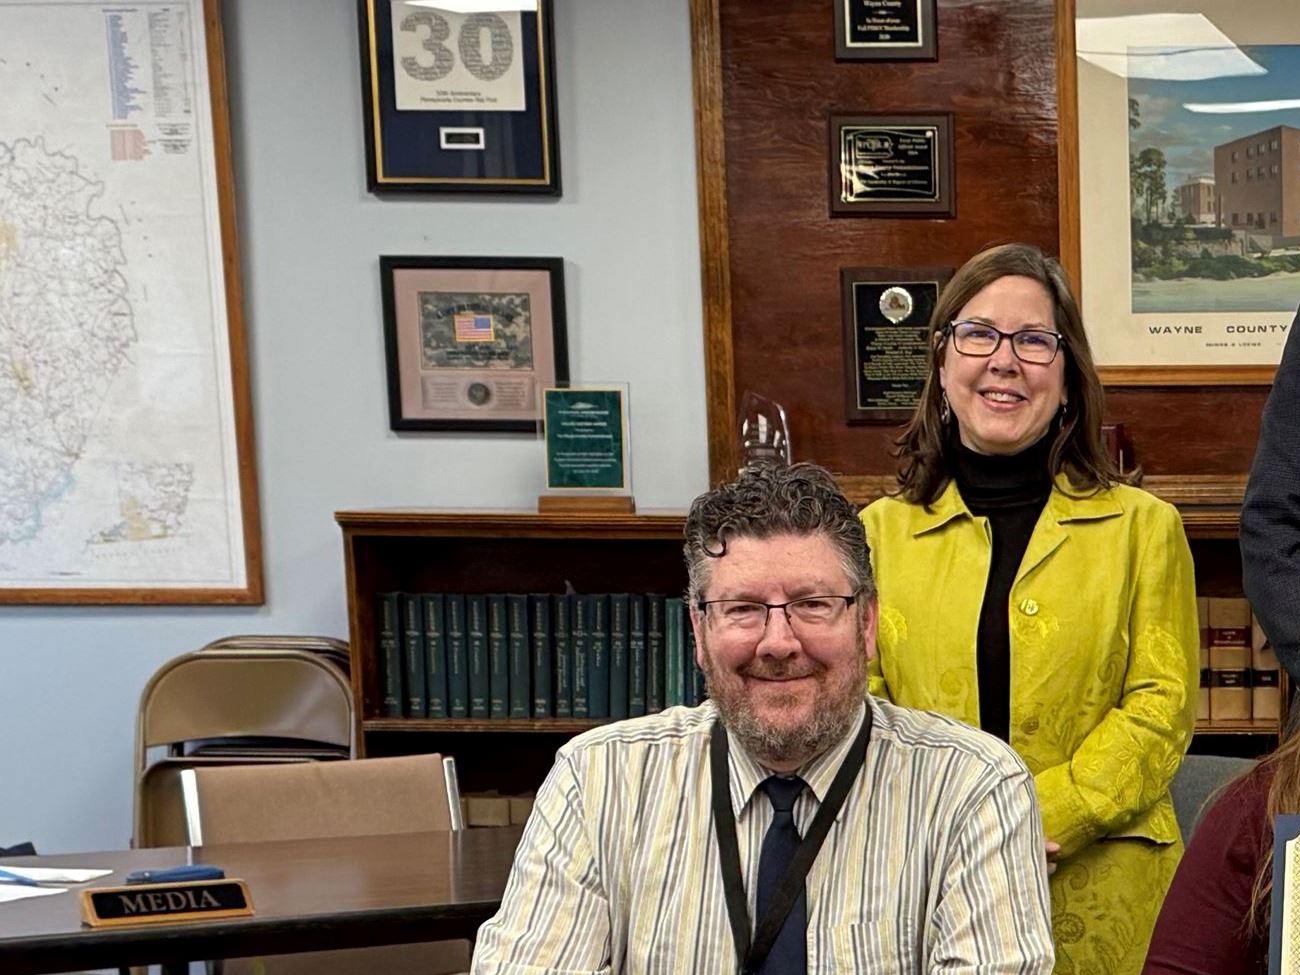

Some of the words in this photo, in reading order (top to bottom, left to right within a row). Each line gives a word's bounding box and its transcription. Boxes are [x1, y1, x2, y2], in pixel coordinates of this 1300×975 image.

[399, 11, 514, 81] 30
[1149, 326, 1202, 334] WAYNE
[1226, 325, 1288, 333] COUNTY
[118, 890, 221, 914] MEDIA
